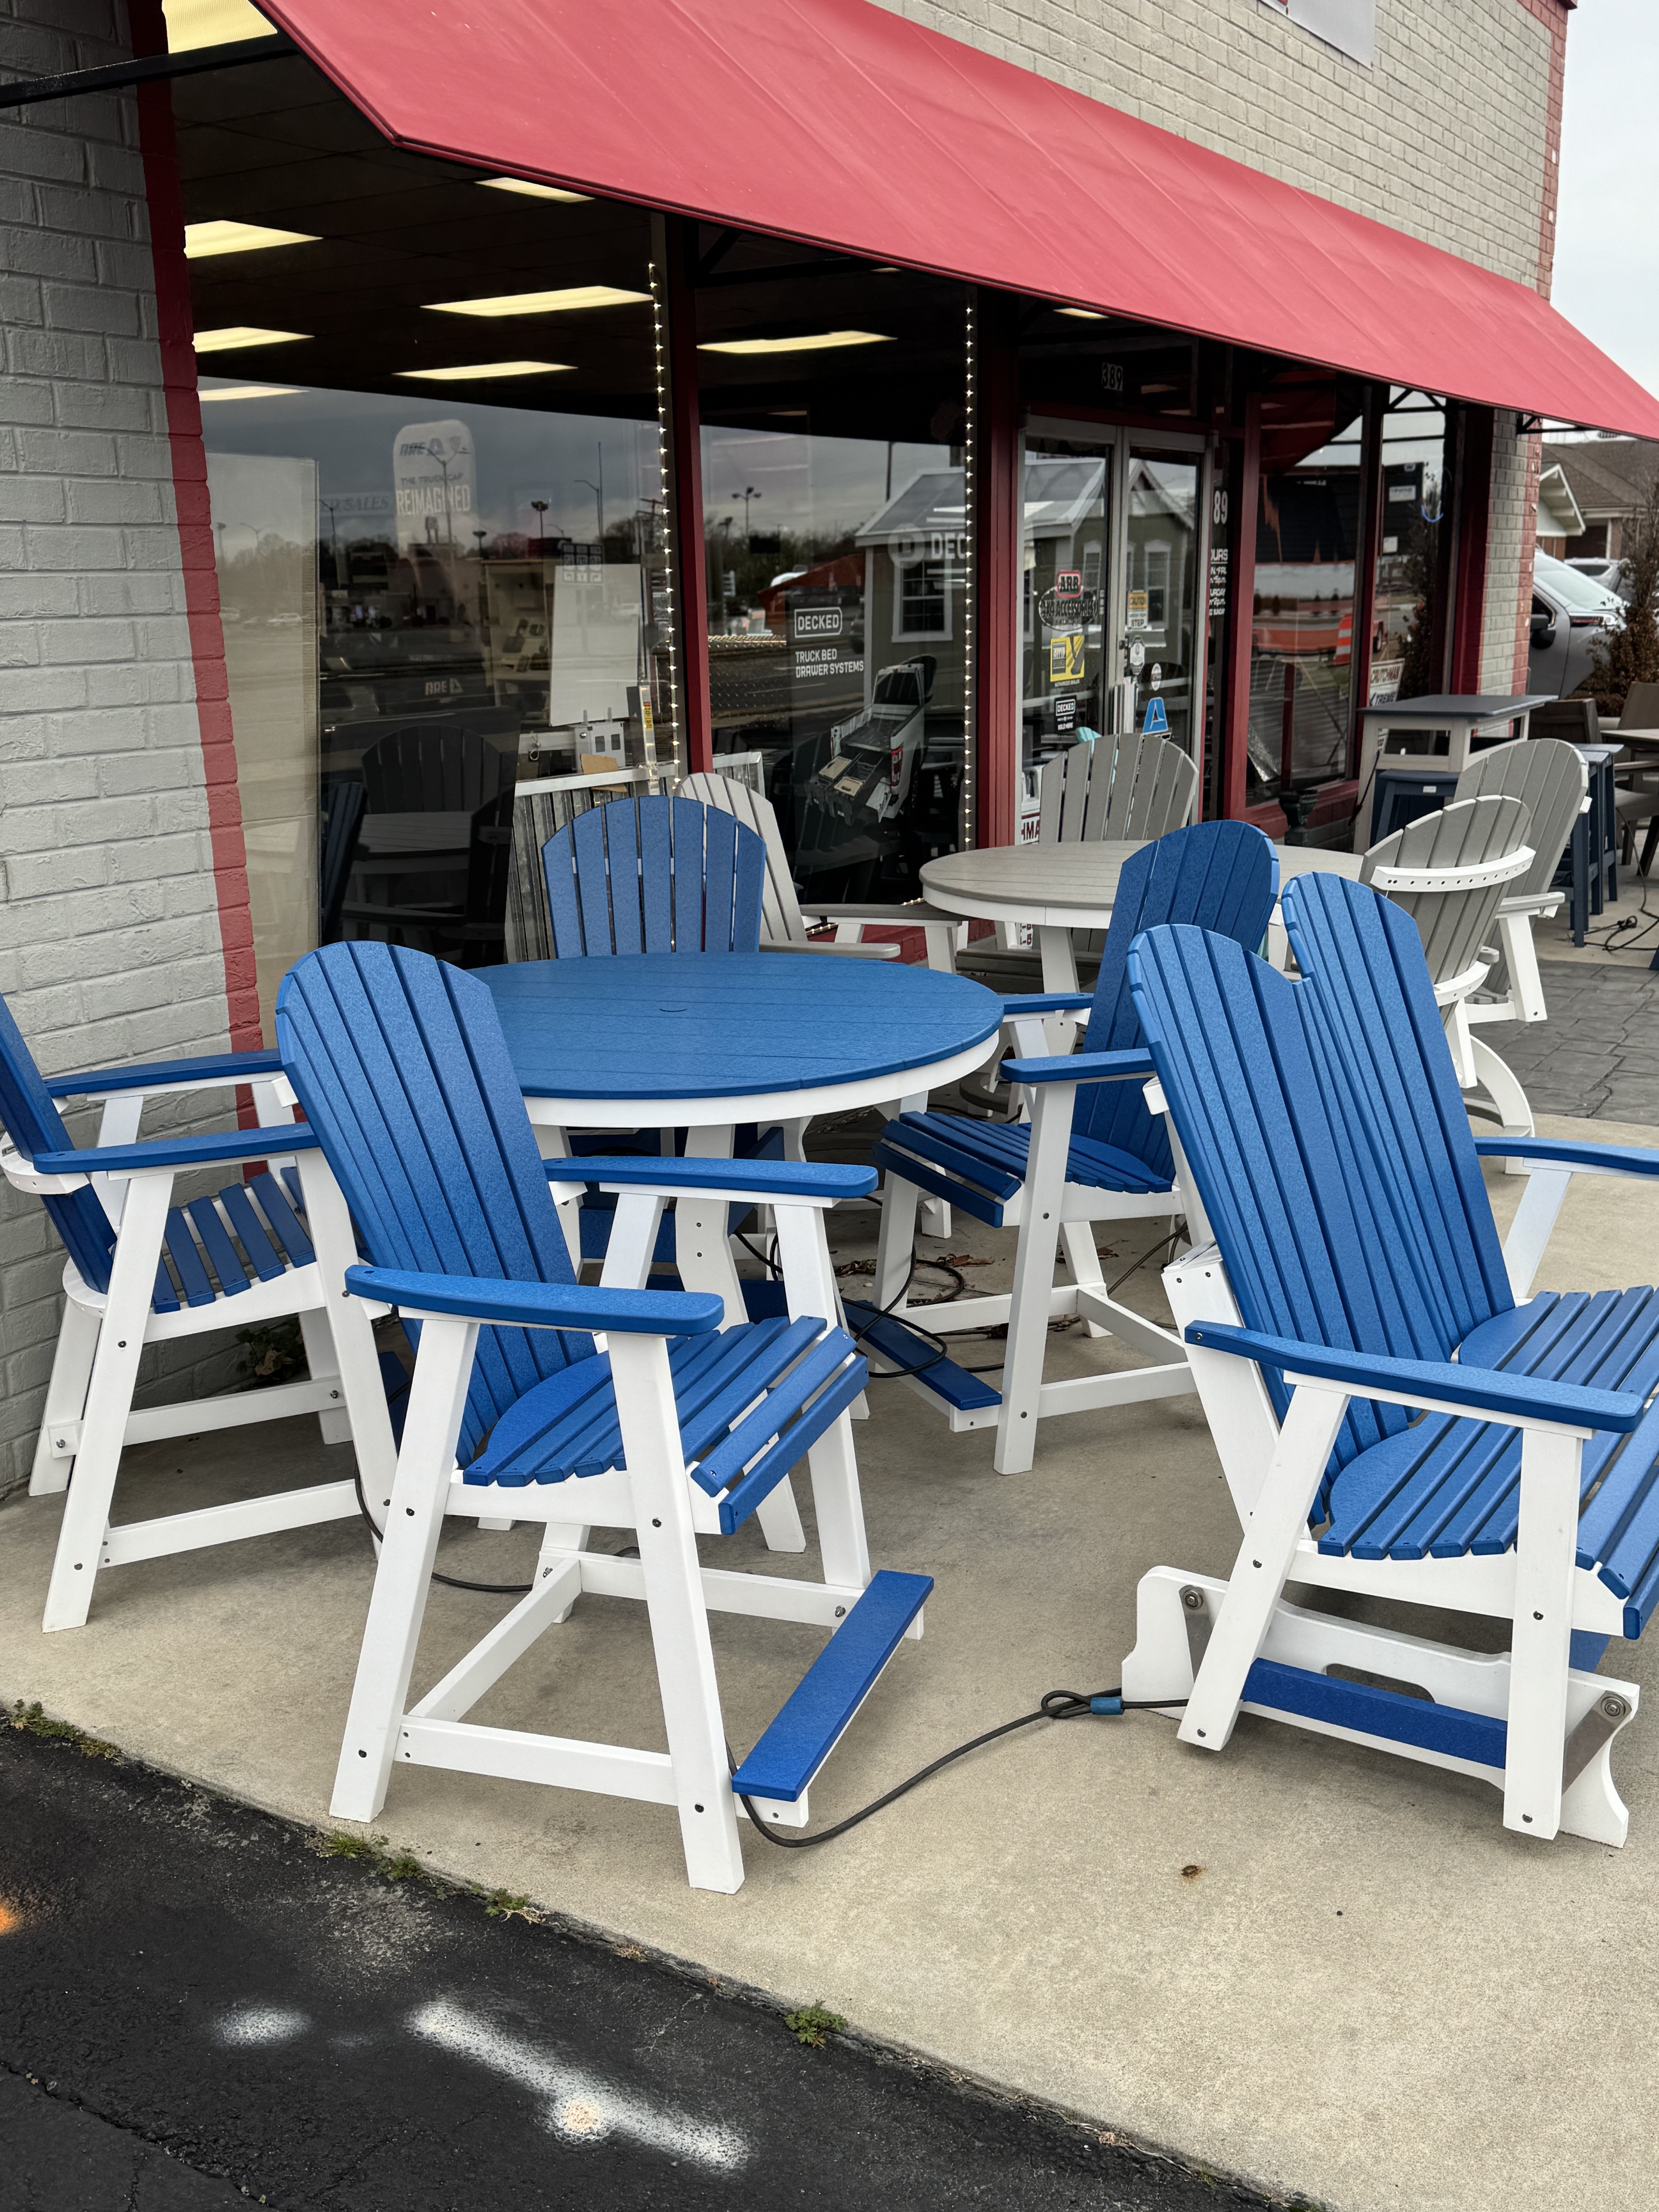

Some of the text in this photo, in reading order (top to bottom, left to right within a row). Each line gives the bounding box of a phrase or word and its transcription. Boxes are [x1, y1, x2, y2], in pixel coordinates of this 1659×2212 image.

[1102, 364, 1122, 390] 389
[418, 475, 444, 483] TRUCK
[446, 473, 463, 481] CAP
[343, 496, 390, 511] SALES
[396, 485, 470, 515] REIMAGINED
[1060, 575, 1079, 592] ARB
[798, 614, 839, 631] DECKED
[1131, 619, 1144, 627] STEP
[795, 648, 837, 663] TRUCK BED
[796, 660, 864, 678] DRAWER SYSTEMS
[1057, 702, 1074, 713] DECKED
